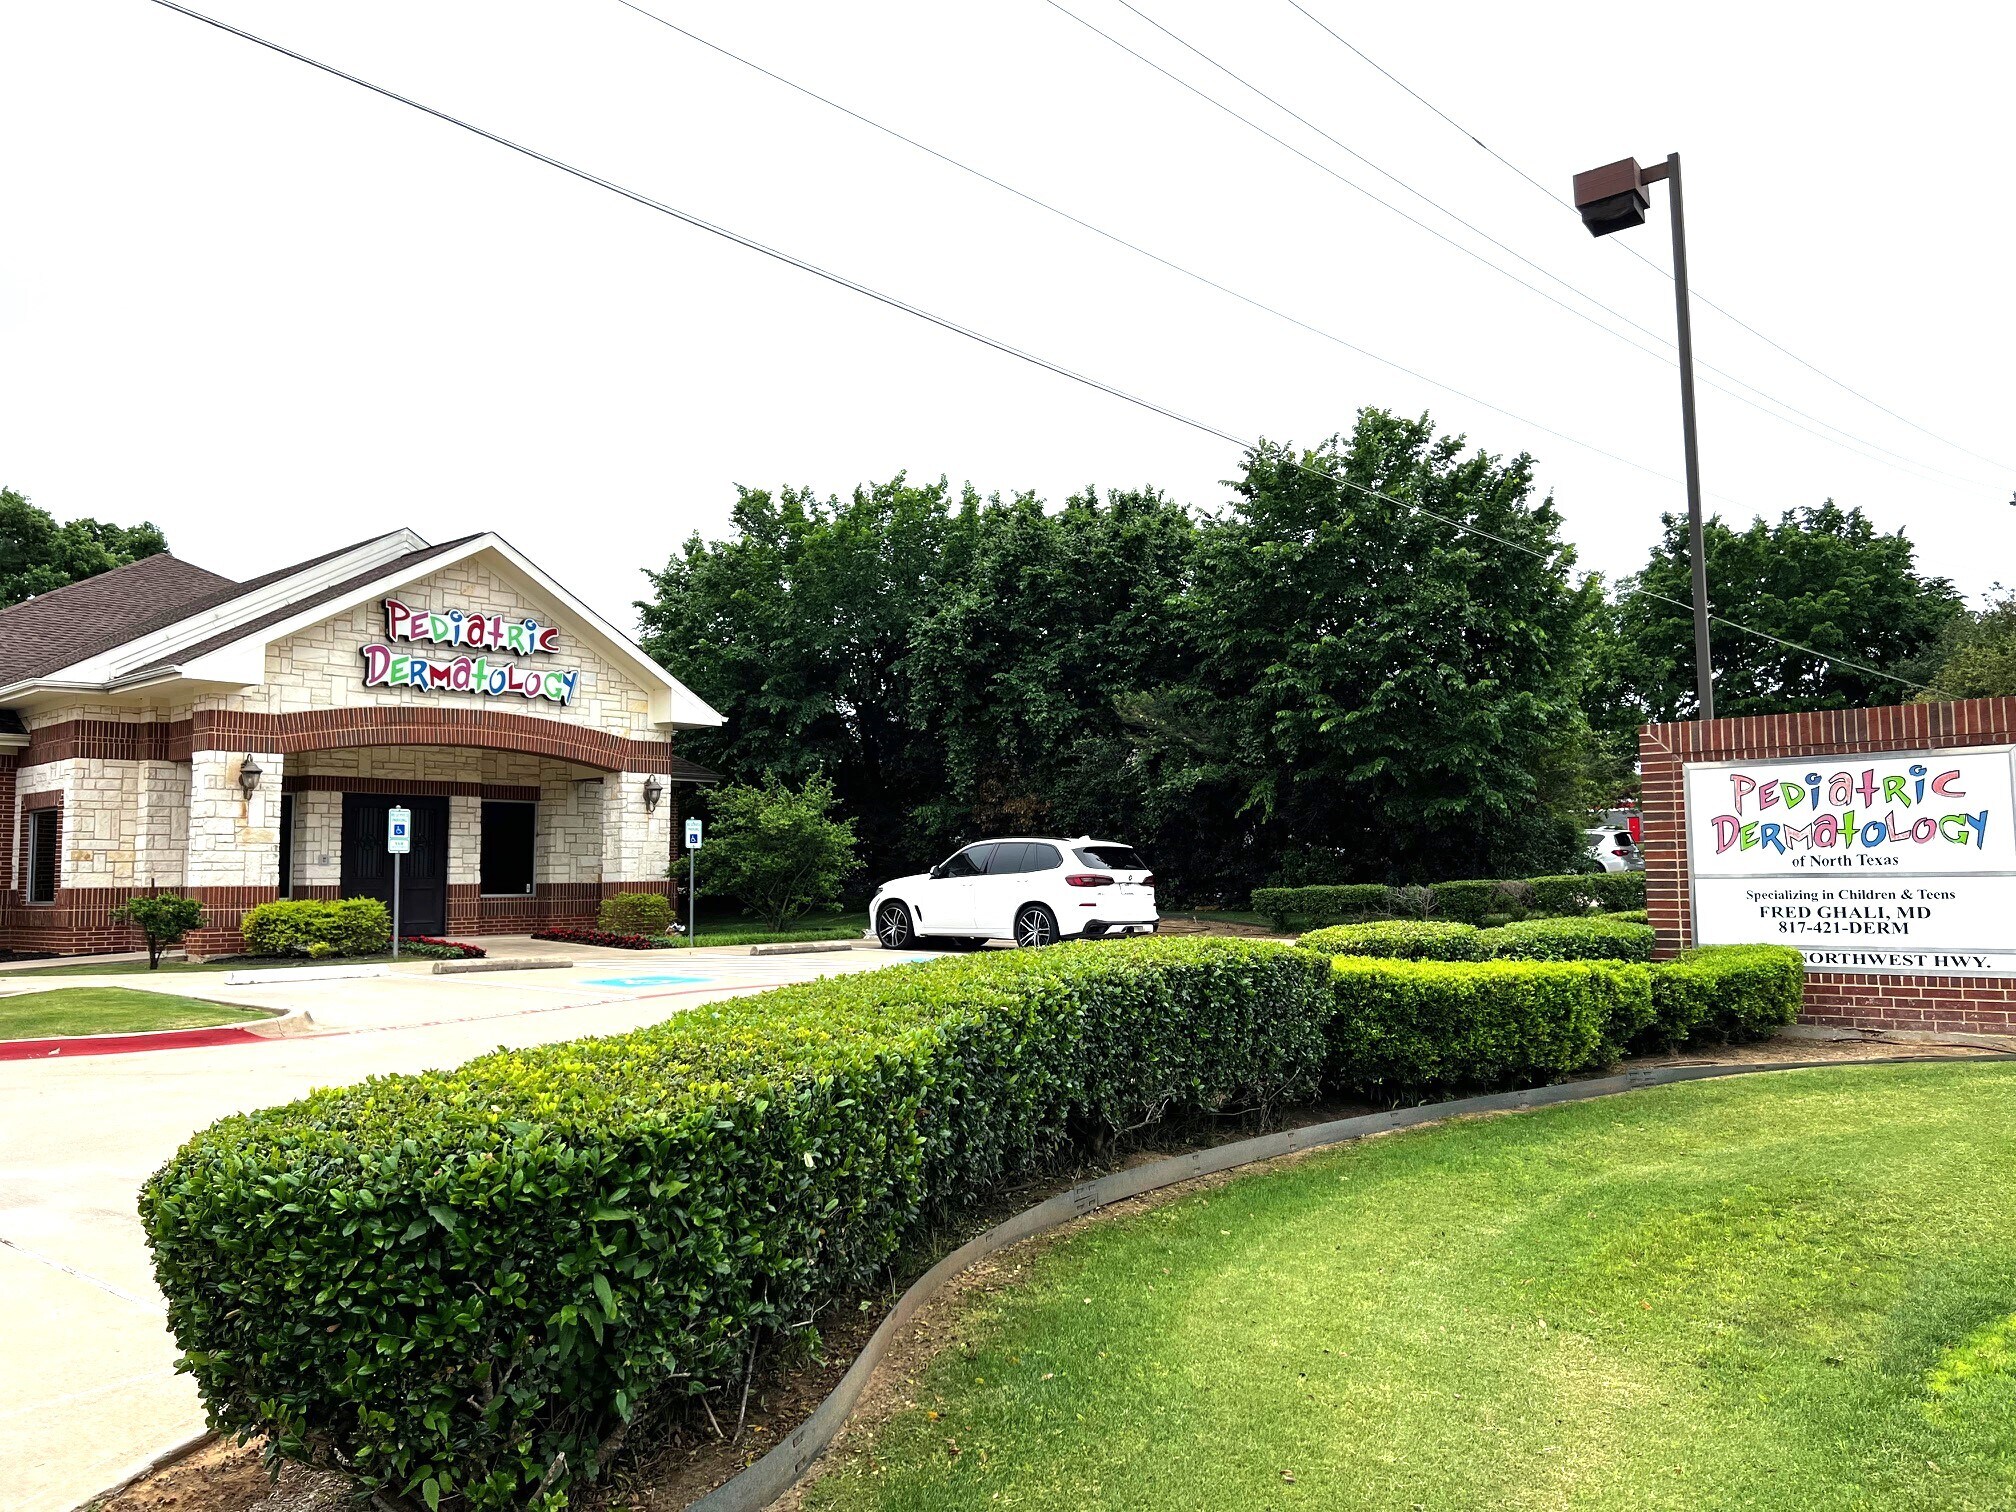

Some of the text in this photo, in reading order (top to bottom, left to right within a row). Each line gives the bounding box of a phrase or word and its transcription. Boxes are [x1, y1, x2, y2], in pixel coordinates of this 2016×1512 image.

[1792, 853, 1899, 867] of North Texas
[1746, 889, 1956, 902] Specializing in Children & Teens
[1760, 906, 1931, 920] FRED GHALI, MD
[1778, 921, 1909, 935] 817-421-DERM
[1934, 955, 1992, 969] HWY.
